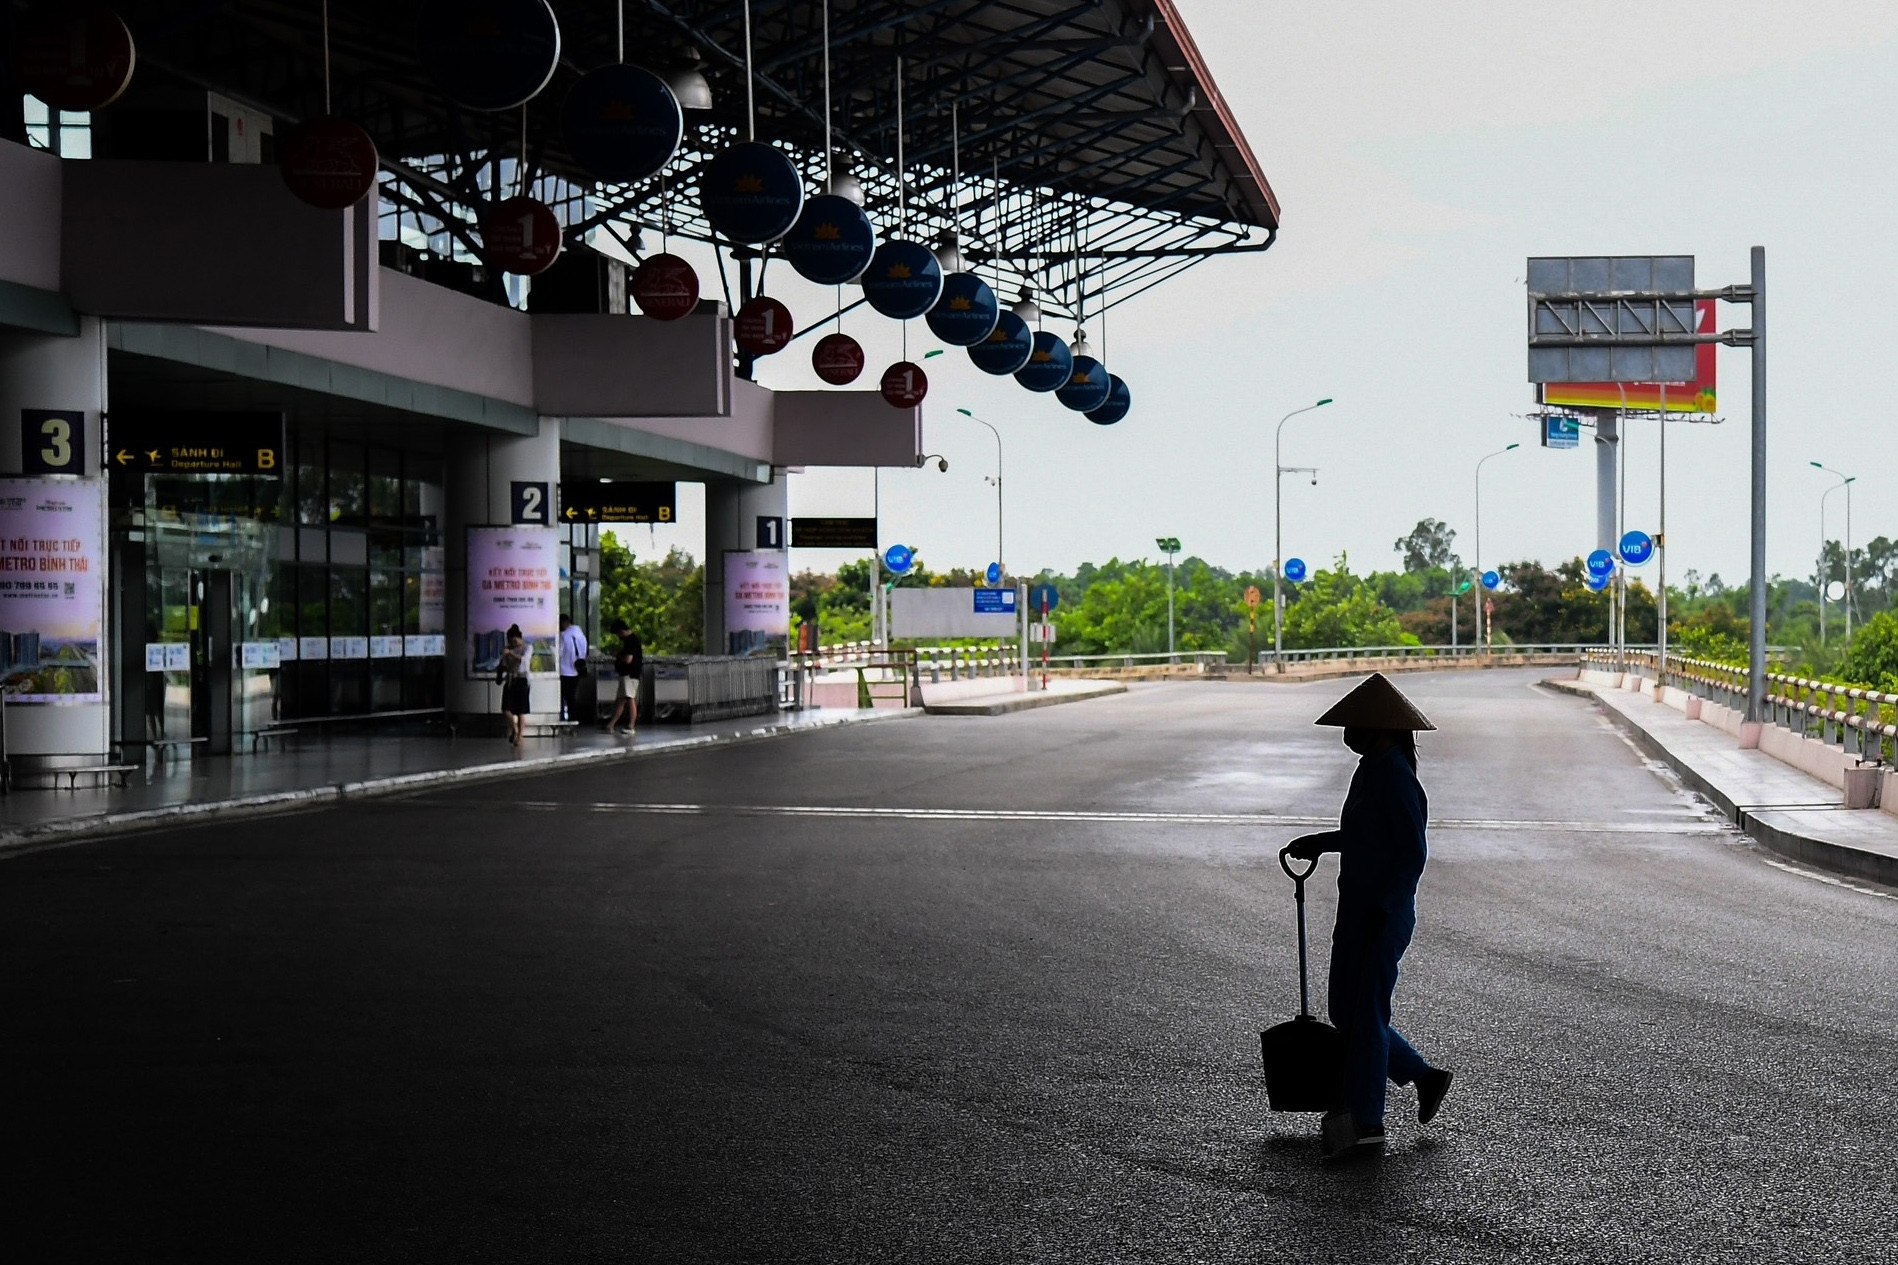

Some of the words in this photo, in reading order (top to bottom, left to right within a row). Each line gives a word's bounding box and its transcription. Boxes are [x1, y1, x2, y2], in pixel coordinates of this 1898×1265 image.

[761, 308, 776, 344] 1
[902, 369, 915, 399] 1
[41, 418, 71, 467] 3
[171, 460, 219, 469] Departure
[223, 460, 242, 468] Hall
[257, 449, 275, 469] B
[522, 487, 542, 520] 2
[658, 506, 671, 521] B
[766, 520, 777, 545] 1
[1622, 545, 1641, 554] VIB
[1590, 560, 1605, 568] VIB
